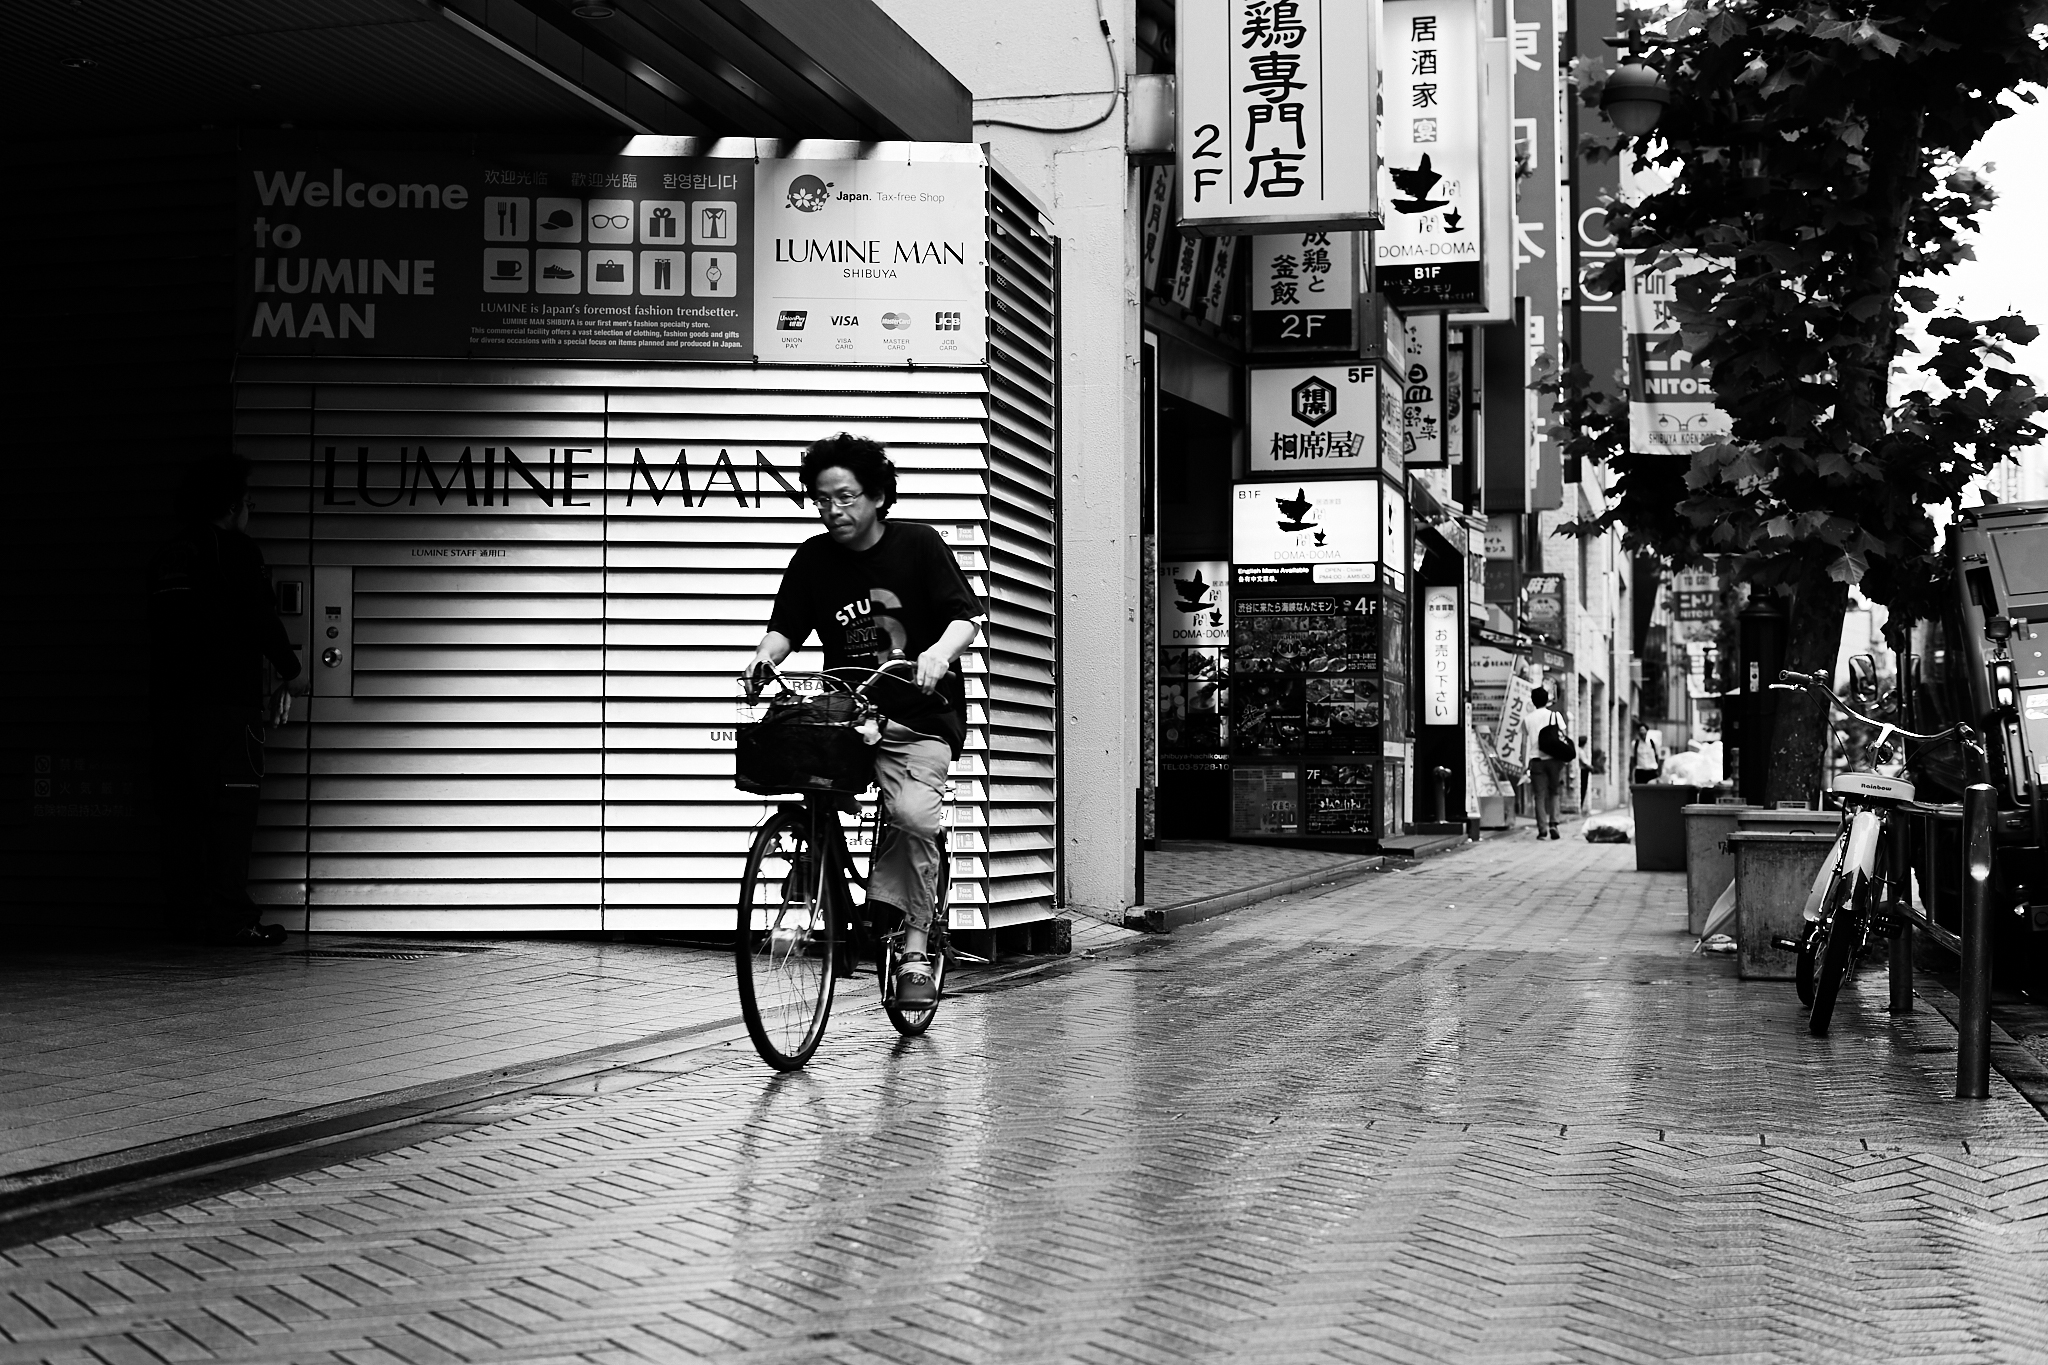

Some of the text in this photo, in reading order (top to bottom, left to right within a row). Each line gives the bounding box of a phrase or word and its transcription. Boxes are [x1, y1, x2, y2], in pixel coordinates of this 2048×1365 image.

[1192, 124, 1223, 203] 2F
[484, 169, 548, 186] 欢迎光临
[571, 172, 638, 188] 歡迎光臨
[662, 173, 738, 190] 환영합니다
[253, 168, 468, 210] Welcome
[836, 191, 945, 203] Japan. Tax-free Shop
[253, 217, 302, 249] to
[775, 238, 964, 265] LUMINE MAN
[1379, 241, 1476, 258] DOMA-DOMA
[253, 257, 435, 295] LUMINE
[843, 268, 898, 279] SHIBUYA
[1271, 255, 1300, 305] 釜飯
[1414, 266, 1441, 280] B1F
[1401, 283, 1452, 295] テンコモリ
[480, 302, 527, 313] LUMINE
[530, 302, 539, 313] is
[583, 303, 631, 315] foremost
[633, 304, 673, 316] fashion
[676, 305, 739, 317] trendsetter.
[252, 302, 376, 339] MAN
[502, 317, 528, 325] LUMINE
[529, 317, 545, 325] MAN
[546, 318, 576, 326] SHIBUYA
[576, 318, 583, 326] is
[596, 318, 612, 326] first
[632, 319, 659, 327] fashion
[658, 320, 690, 329] specialty
[690, 320, 711, 328] store.
[830, 315, 860, 327] VISA
[881, 317, 911, 325] MasterCard
[935, 317, 961, 326] JCB
[1280, 313, 1327, 339] 2F
[470, 326, 485, 334] This
[526, 327, 550, 336] facility
[550, 327, 571, 335] offers
[593, 328, 624, 336] selection
[624, 328, 632, 336] of
[632, 329, 662, 338] clothing,
[662, 329, 688, 337] fashion
[688, 330, 709, 338] goods
[709, 330, 723, 338] and
[723, 330, 740, 339] gifts
[469, 335, 480, 343] for
[563, 337, 587, 346] special
[587, 337, 607, 345] focus
[617, 338, 637, 346] items
[637, 338, 665, 347] planned
[665, 339, 679, 347] and
[679, 339, 711, 348] produced
[711, 339, 719, 347] in
[719, 339, 743, 349] Japan.
[1348, 367, 1374, 383] 5F
[1644, 377, 1717, 395] NITOR
[1270, 430, 1354, 461] 相席屋
[1648, 432, 1677, 445] SHIBUYA
[323, 446, 806, 509] LUMINE MAN
[1238, 490, 1261, 500] B1F
[411, 548, 506, 557] LUMINE STAFF 通用口
[1274, 550, 1342, 560] DOMA-DOMA
[1237, 567, 1262, 575] English
[1280, 566, 1310, 574] Available
[1354, 596, 1377, 615] 4F
[1173, 629, 1230, 639] DOMA-DOM
[1435, 629, 1448, 717] お売り下さい
[1501, 696, 1523, 758] カラオケ
[1306, 769, 1321, 780] 7F
[1860, 783, 1892, 792] Rainbow
